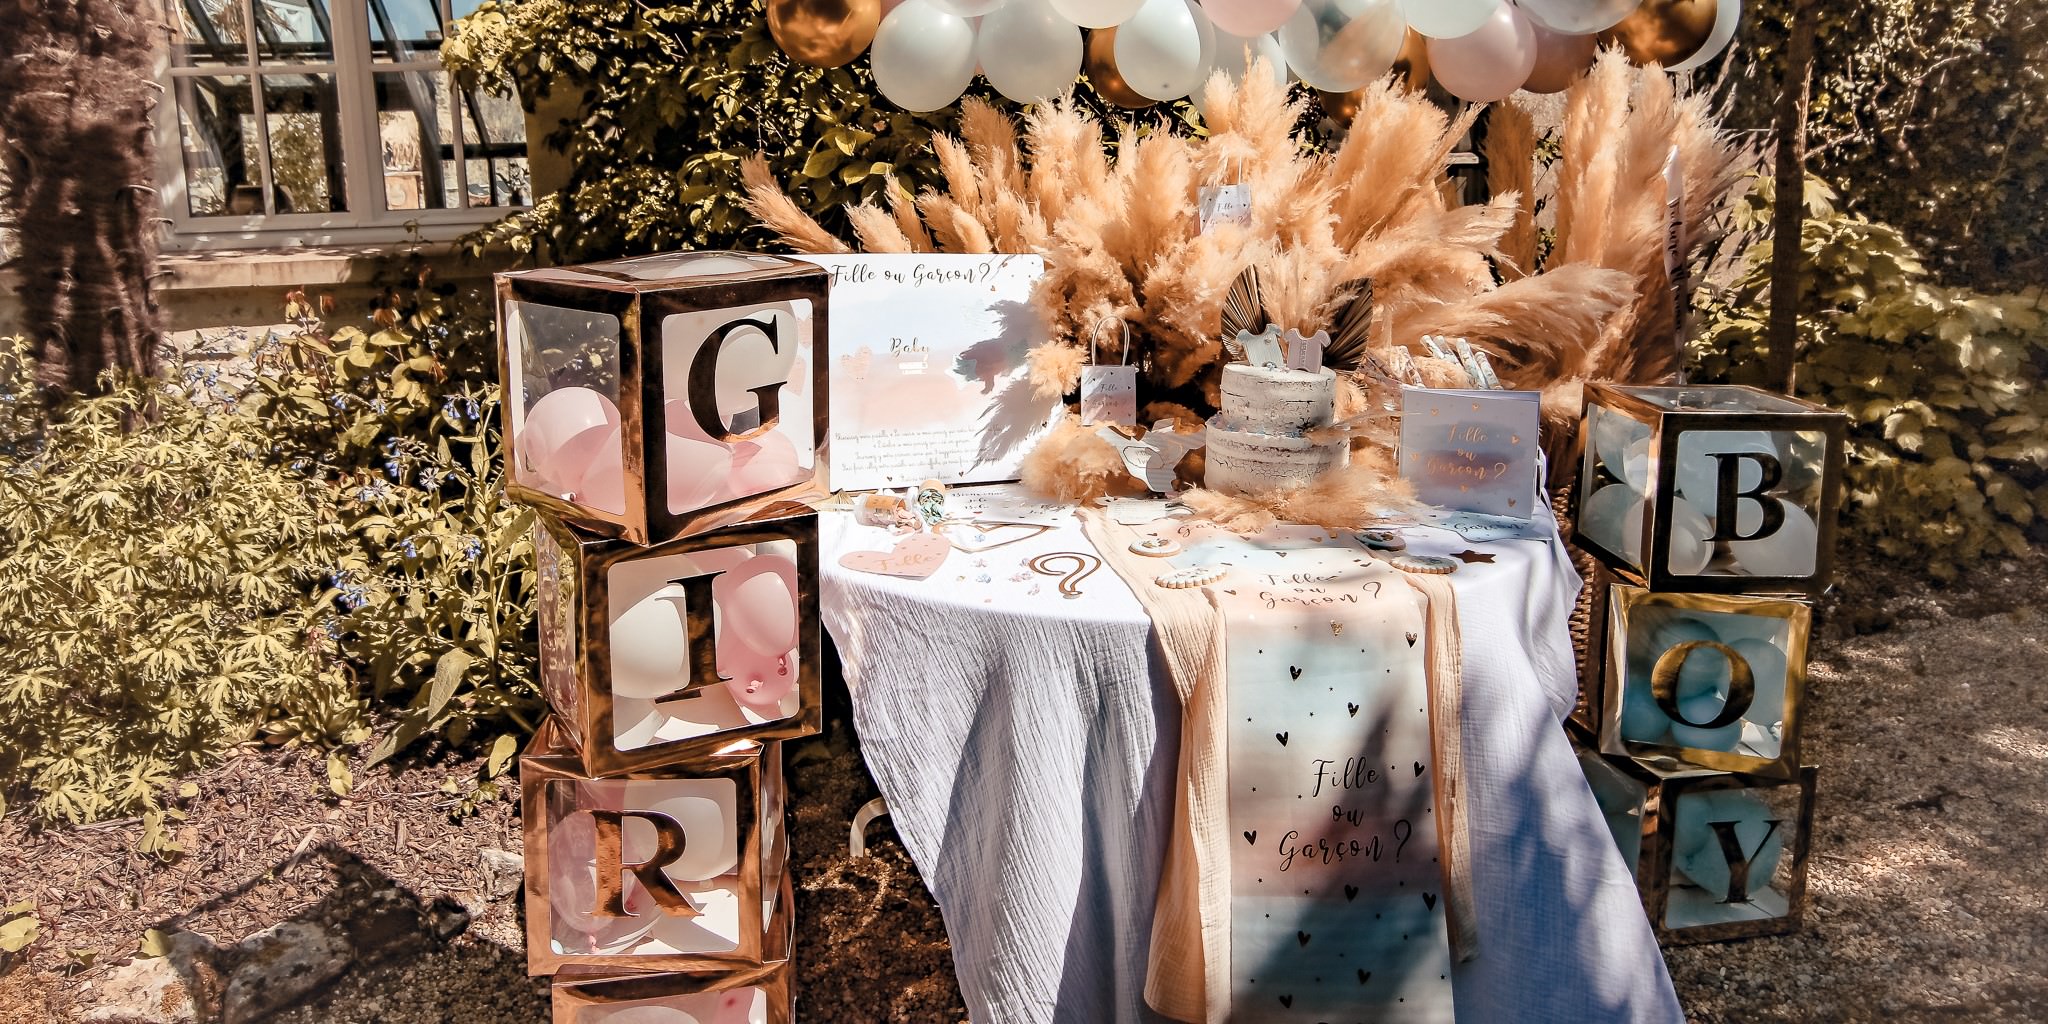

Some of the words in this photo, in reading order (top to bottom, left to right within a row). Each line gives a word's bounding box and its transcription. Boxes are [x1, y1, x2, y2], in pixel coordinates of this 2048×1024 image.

[832, 263, 876, 288] Fille
[885, 270, 906, 284] ou
[688, 314, 786, 443] G
[1448, 424, 1488, 443] Fille
[1456, 448, 1477, 462] ou
[1702, 452, 1785, 542] B
[1262, 573, 1338, 586] Fille
[653, 569, 732, 704] I
[1651, 639, 1756, 730] O
[1311, 756, 1380, 798] Fille
[1332, 804, 1364, 828] ou
[588, 809, 706, 919] R
[1278, 830, 1384, 872] Garçon
[1393, 818, 1412, 864] ?
[1708, 819, 1784, 904] Y
